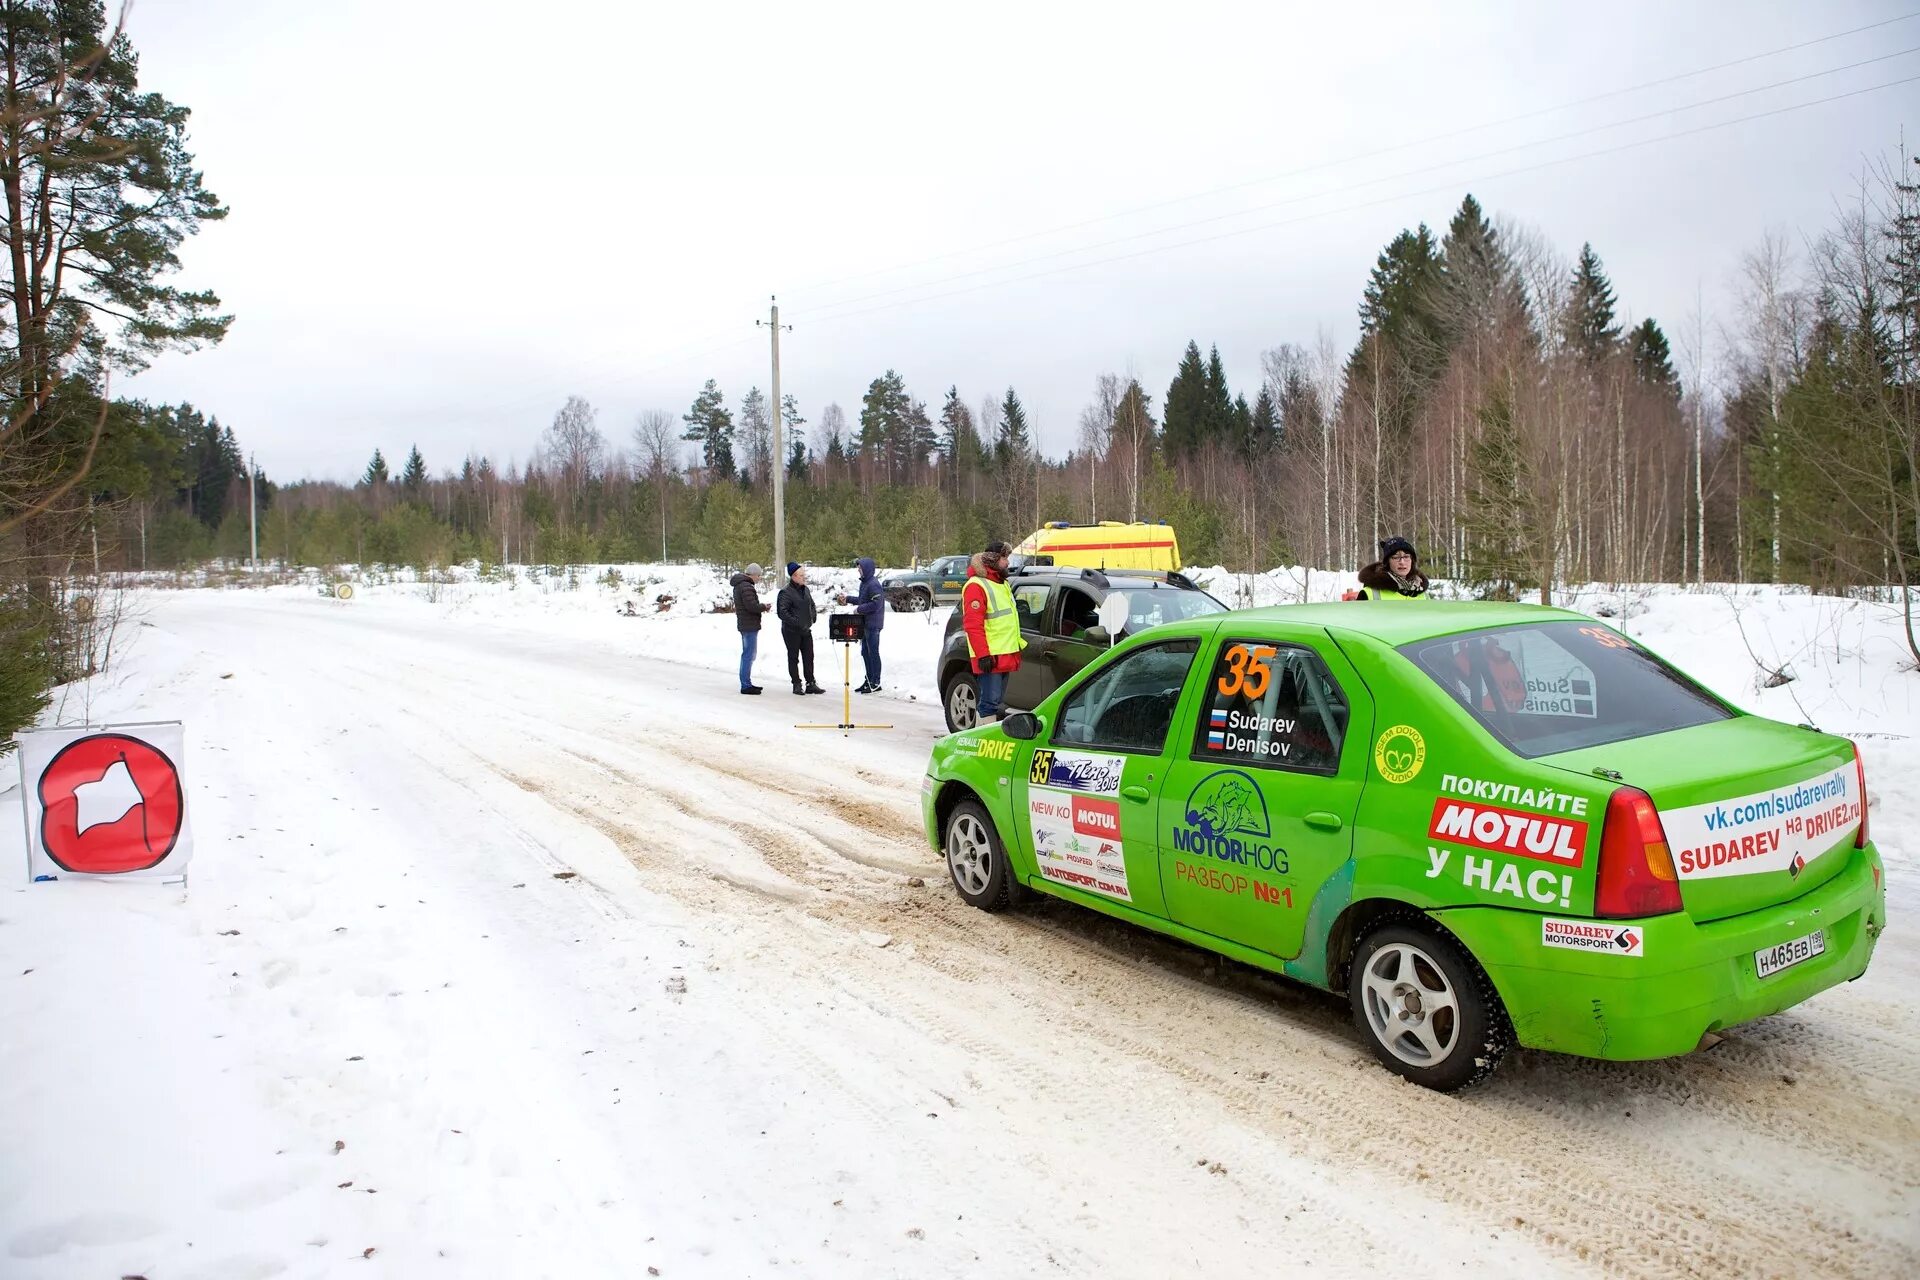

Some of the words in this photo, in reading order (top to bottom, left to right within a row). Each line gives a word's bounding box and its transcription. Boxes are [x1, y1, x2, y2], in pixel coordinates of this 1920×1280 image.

[1578, 627, 1630, 648] 35
[1218, 645, 1277, 698] 35
[1229, 710, 1295, 734] Sudarev
[977, 739, 1016, 761] DRIVE
[1225, 733, 1290, 757] Denisov
[1377, 729, 1394, 757] VSEM
[1396, 727, 1424, 763] DOVOLEN
[1031, 751, 1052, 784] 35
[1381, 767, 1414, 782] STUDIO
[1095, 776, 1120, 792] 2016
[1441, 774, 1589, 816] ПОКУПАЙТЕ
[1031, 801, 1054, 816] NEW
[1704, 772, 1846, 831] vk.com/sudarevrally
[1077, 809, 1117, 829] MOTUL
[1435, 804, 1577, 860] MOTUL
[1173, 826, 1289, 874] MOTORHOG
[1680, 828, 1780, 874] SUDAREV
[1805, 801, 1860, 840] DRIVE2.ru
[1175, 861, 1248, 895] РАЗБОР
[1462, 854, 1573, 908] НАС!
[1545, 922, 1615, 939] SUDAREV
[1545, 934, 1615, 949] MOTORSPORT
